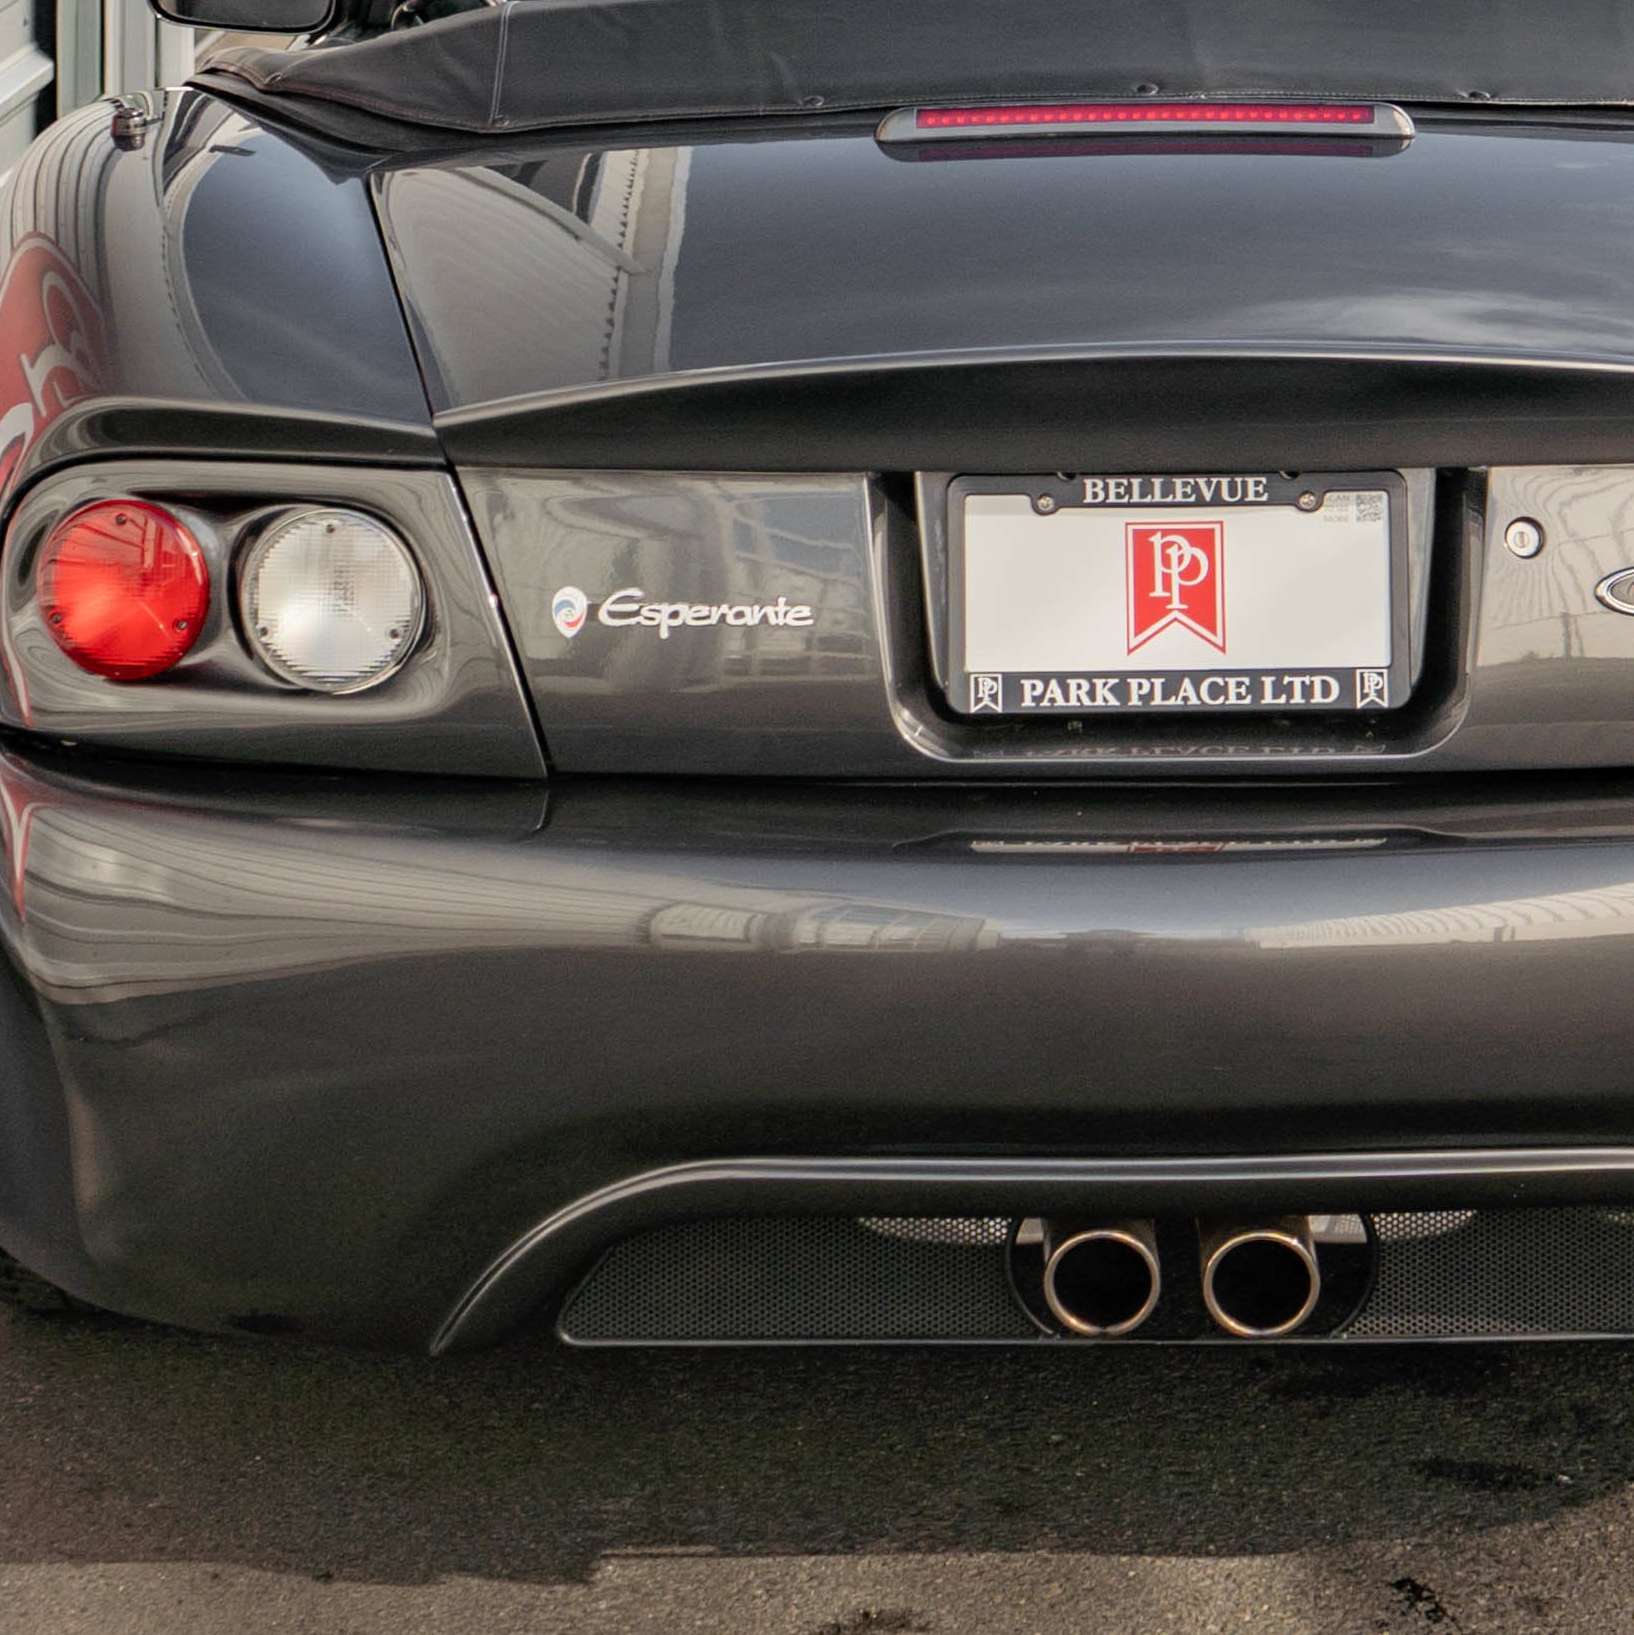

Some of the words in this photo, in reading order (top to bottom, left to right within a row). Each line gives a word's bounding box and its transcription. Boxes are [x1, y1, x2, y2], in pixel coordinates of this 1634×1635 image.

[1083, 476, 1269, 504] BELLEVUE
[598, 587, 814, 639] Esperante
[1020, 678, 1121, 707] PARK
[1127, 676, 1252, 706] PLACE
[1261, 675, 1341, 704] LTD
